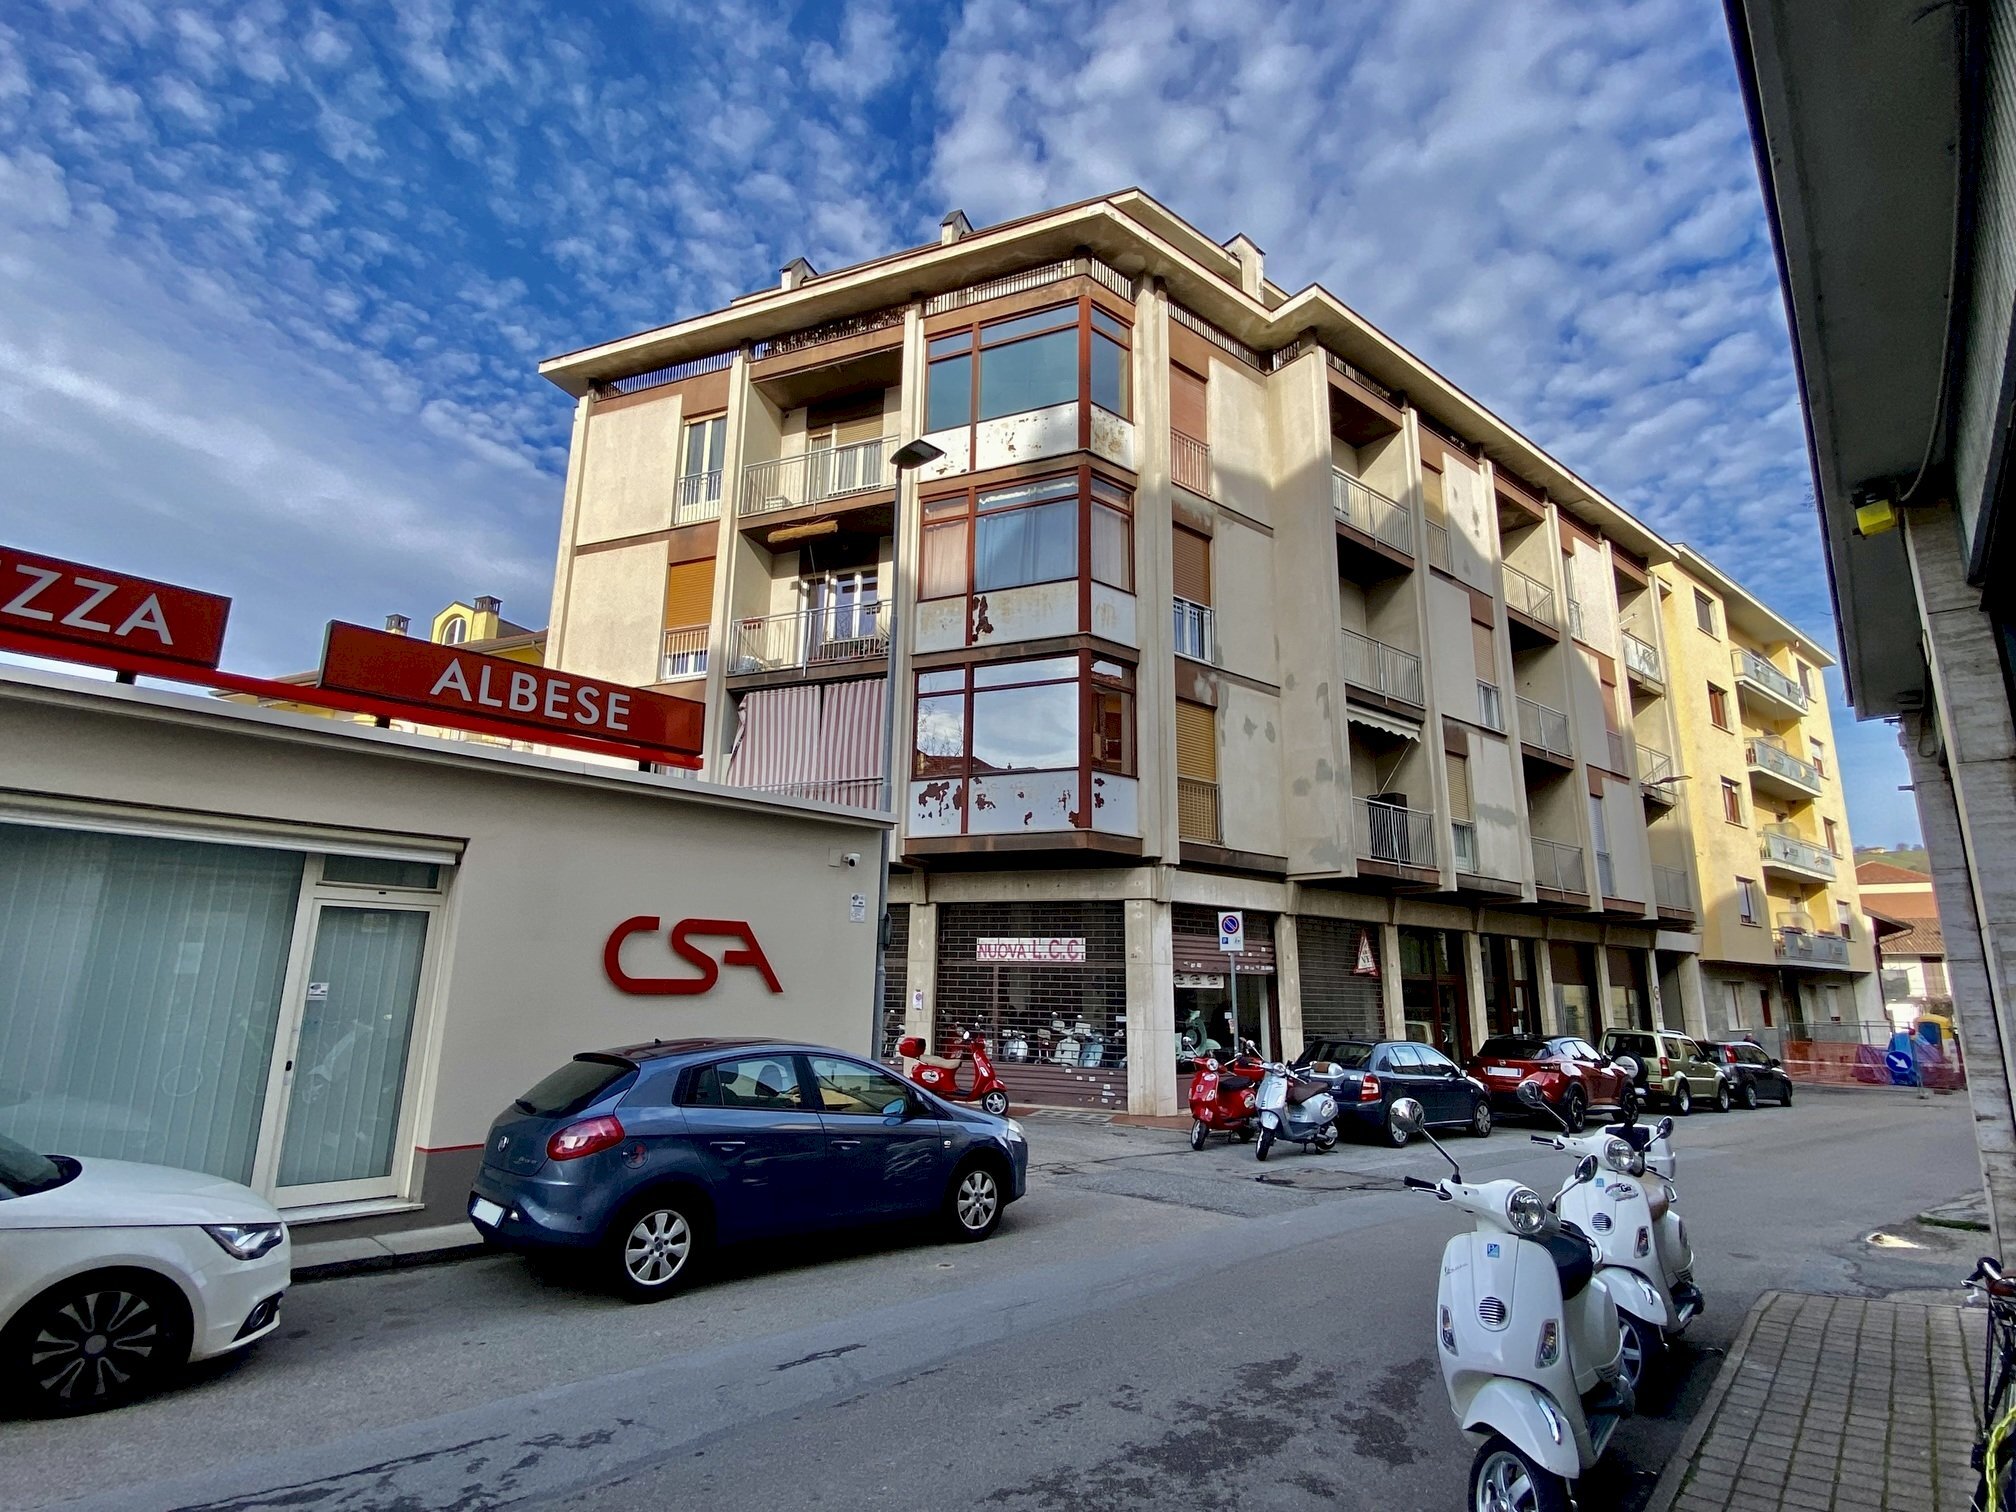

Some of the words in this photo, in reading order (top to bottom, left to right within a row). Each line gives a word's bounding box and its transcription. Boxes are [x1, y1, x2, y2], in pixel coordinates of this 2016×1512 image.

[0, 560, 173, 645] ZZA
[429, 657, 631, 731] ALBESE
[604, 915, 784, 995] CSA
[977, 943, 1027, 959] NUOVA
